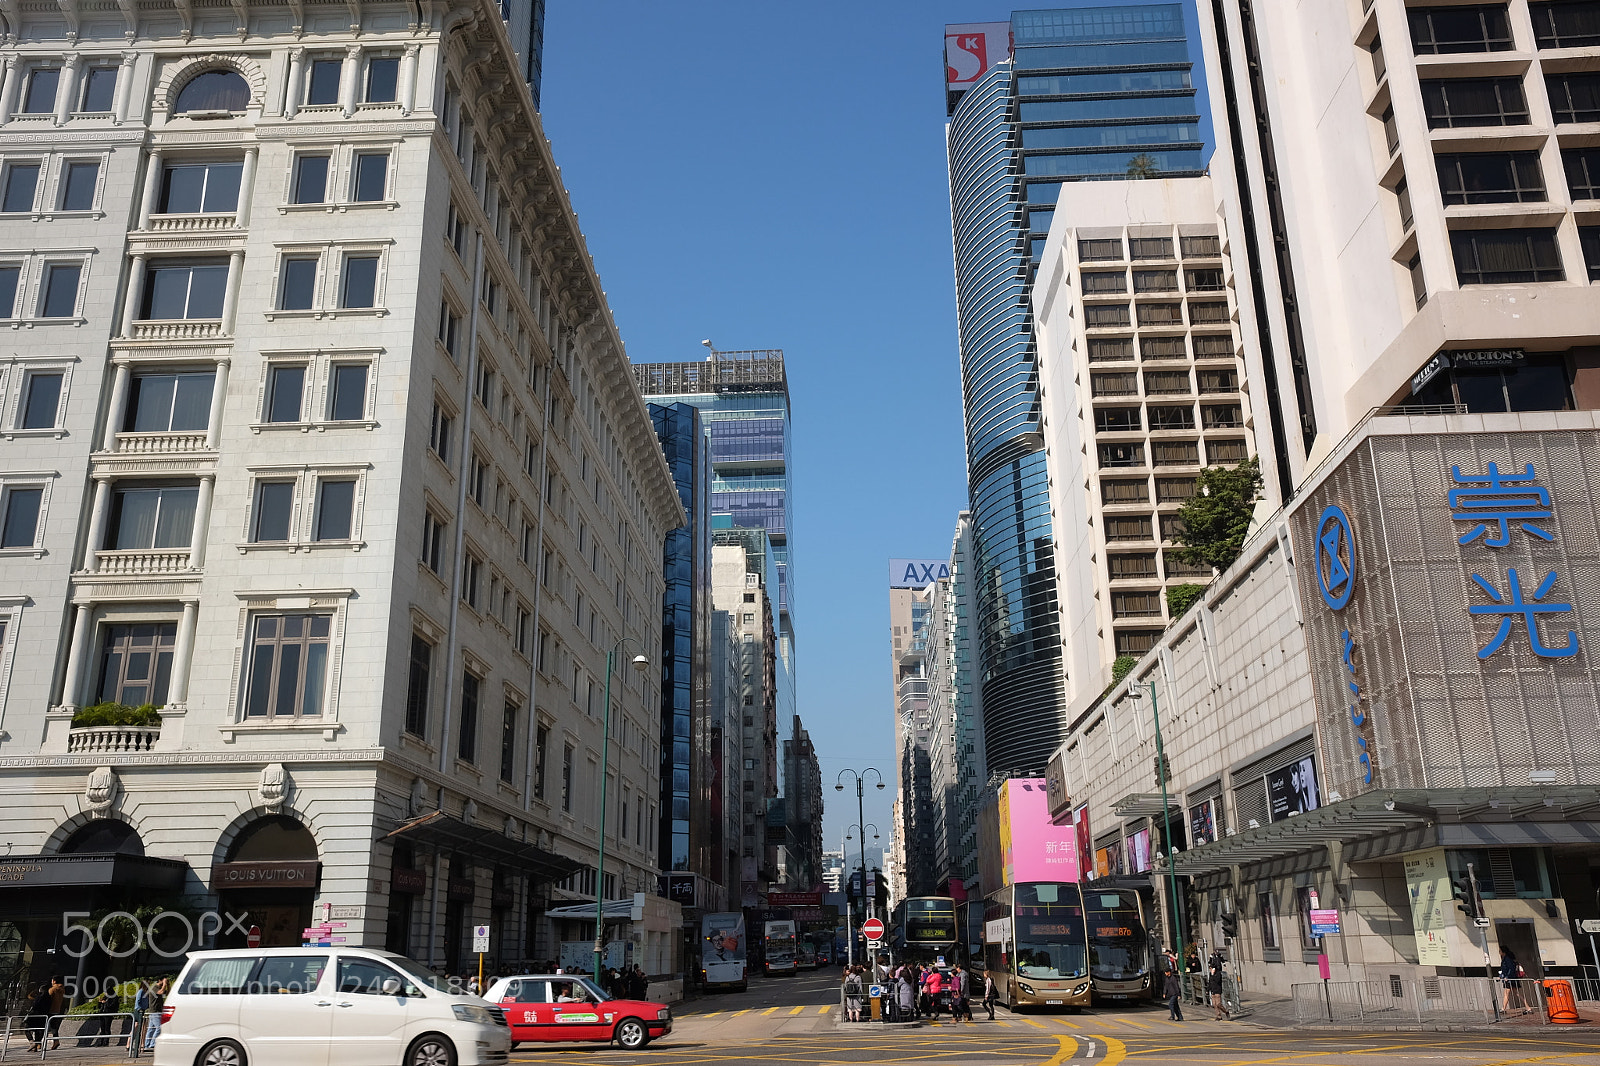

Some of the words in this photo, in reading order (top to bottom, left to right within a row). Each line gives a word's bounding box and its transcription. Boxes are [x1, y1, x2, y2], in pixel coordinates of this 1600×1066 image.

[1456, 351, 1524, 362] MORTON'S
[1448, 462, 1579, 660] 崇光
[903, 563, 950, 583] AXA
[1045, 841, 1076, 854] 新年
[225, 870, 256, 880] LOUIS
[258, 869, 305, 880] VUITTON
